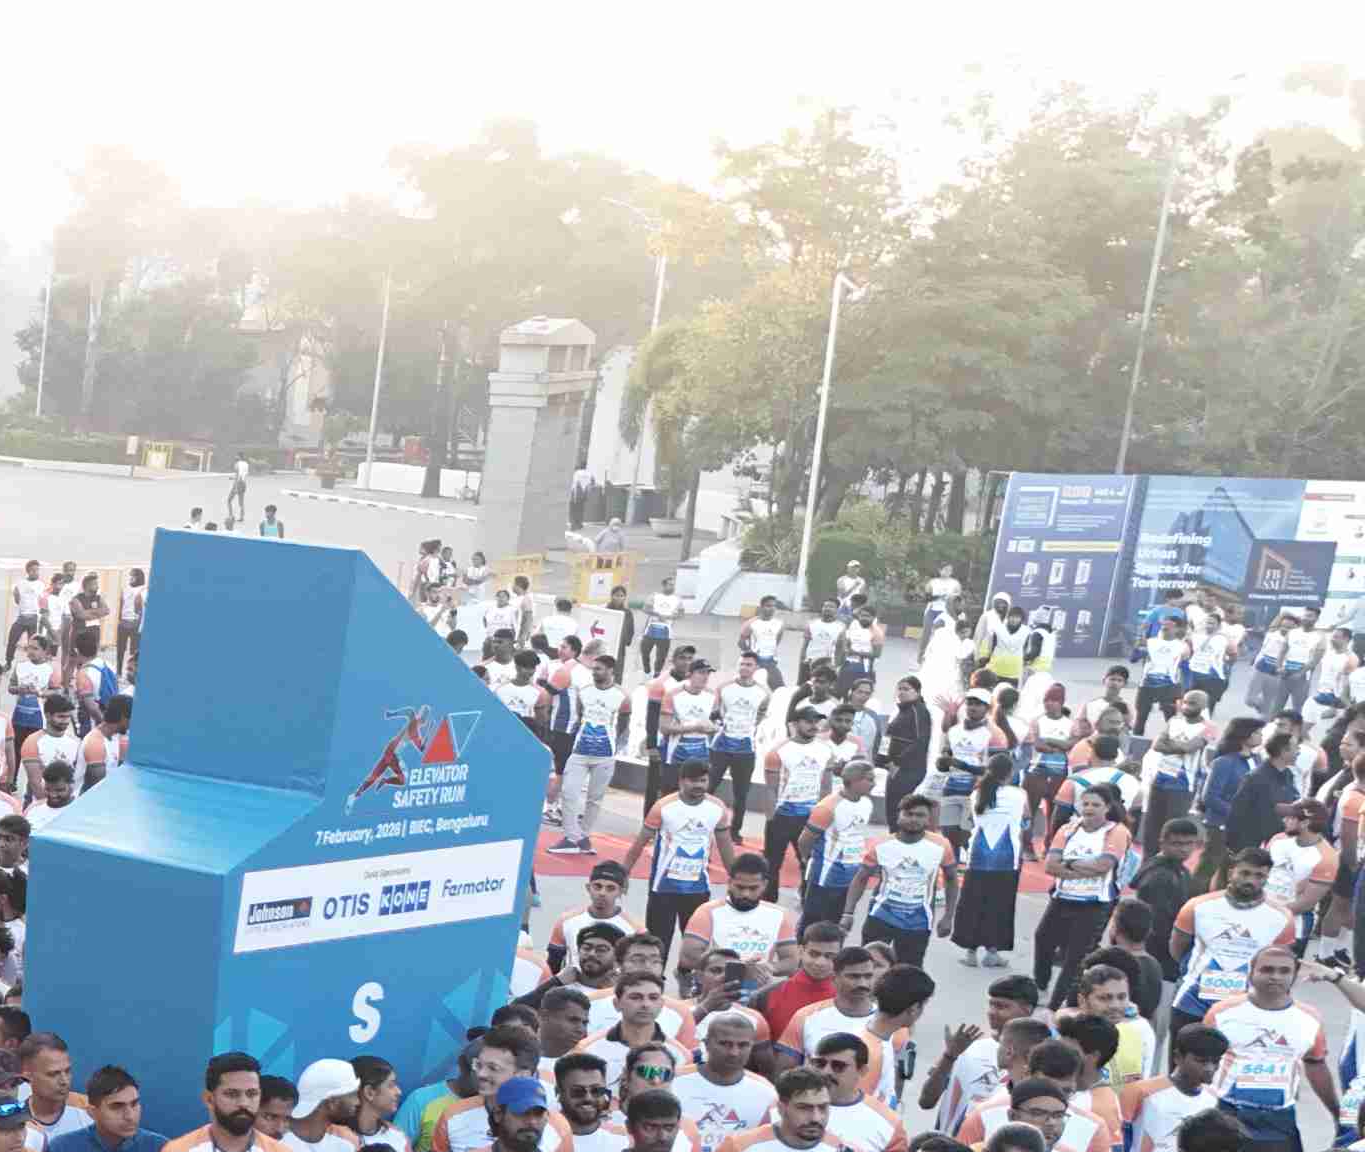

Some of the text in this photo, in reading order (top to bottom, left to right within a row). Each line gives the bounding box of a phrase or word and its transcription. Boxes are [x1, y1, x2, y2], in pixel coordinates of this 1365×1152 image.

[409, 764, 469, 786] ELEVATOR
[392, 783, 467, 808] SAFETY RUN
[323, 826, 375, 845] February,
[436, 813, 489, 834] Bengaluru
[323, 893, 370, 920] OTIS
[380, 885, 429, 911] KONE
[349, 982, 384, 1043] S
